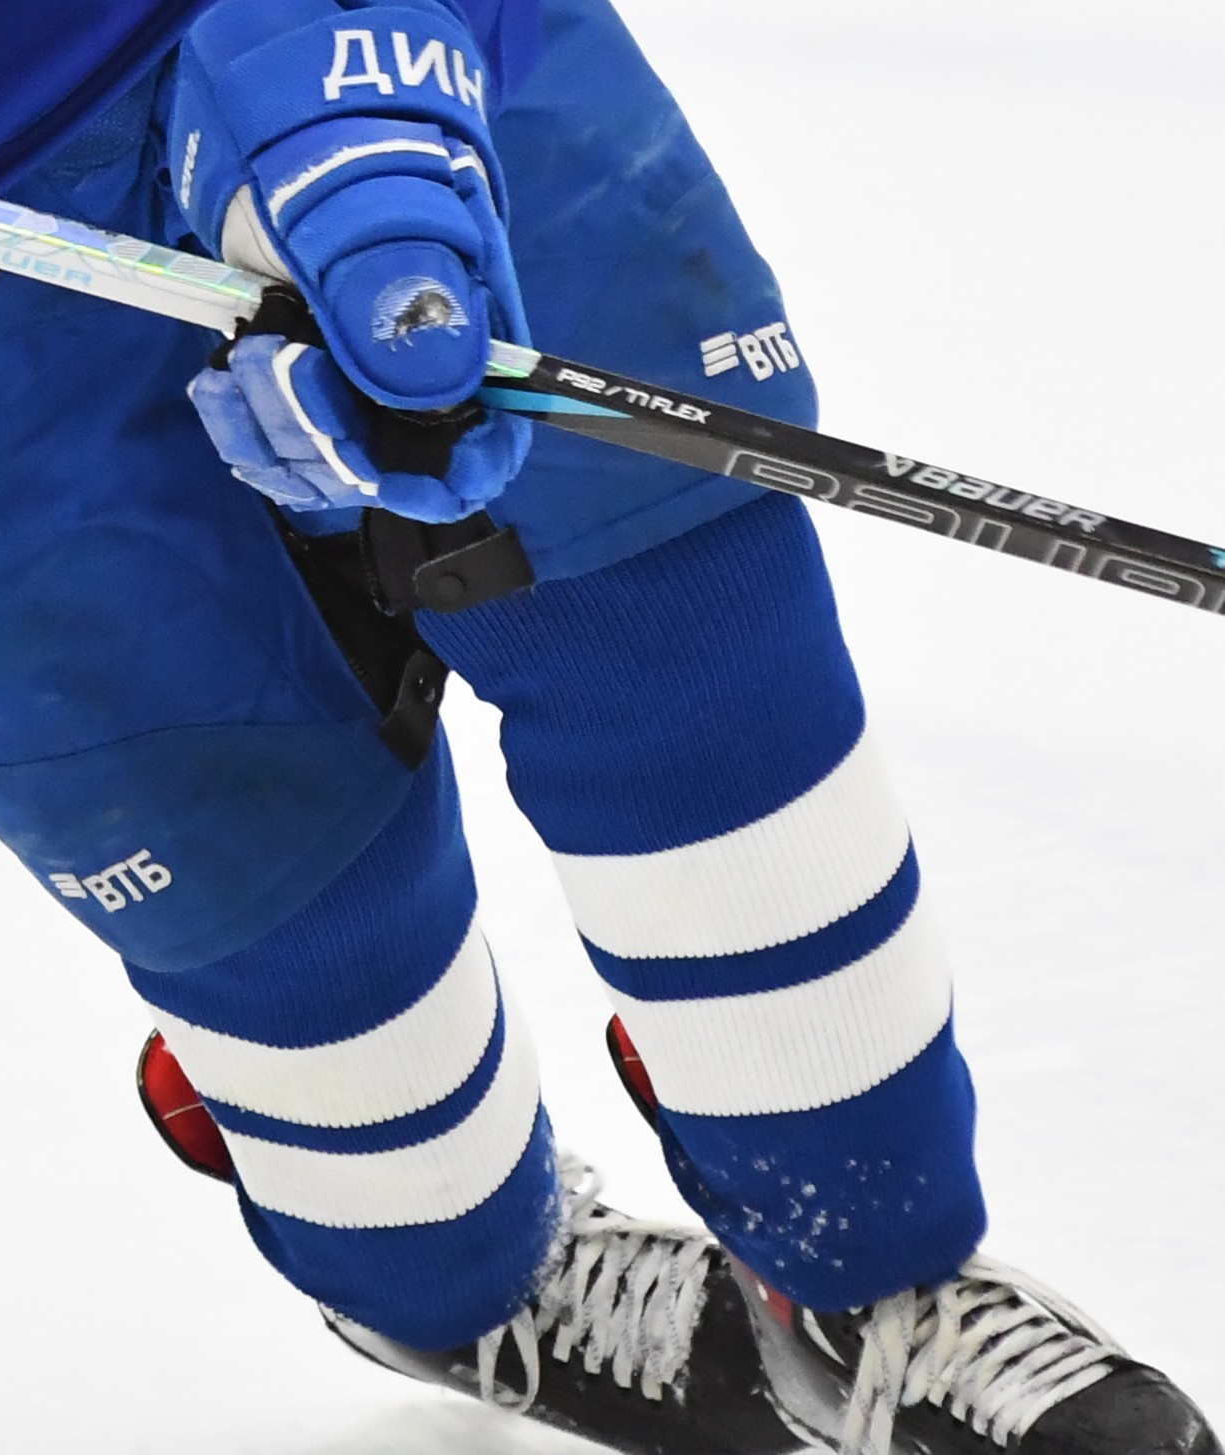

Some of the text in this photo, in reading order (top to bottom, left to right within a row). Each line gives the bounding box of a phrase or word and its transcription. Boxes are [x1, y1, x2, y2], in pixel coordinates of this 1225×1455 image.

[322, 29, 488, 126] ДИН
[738, 321, 800, 382] ВТБ
[909, 455, 1109, 525] BAUER
[81, 848, 172, 913] ВТБ
